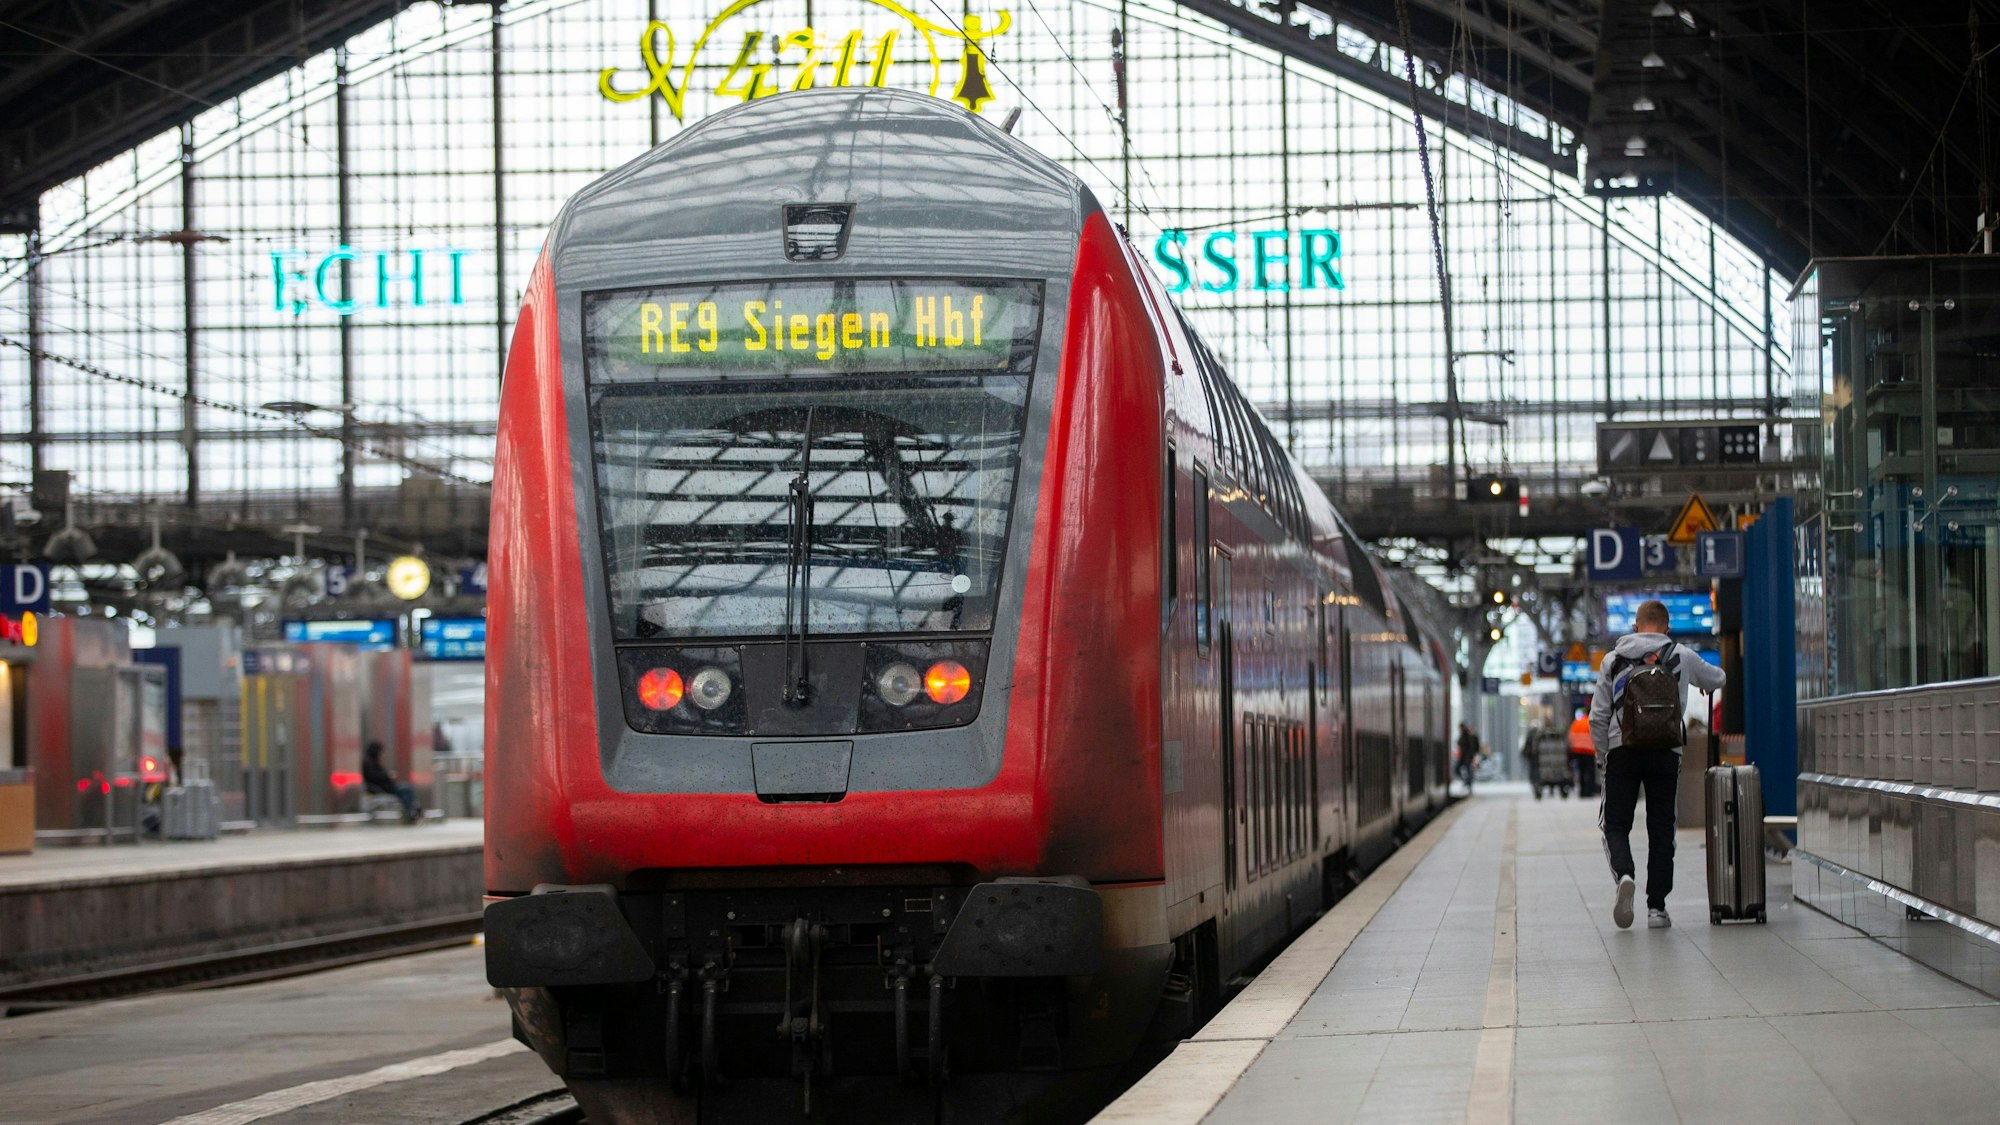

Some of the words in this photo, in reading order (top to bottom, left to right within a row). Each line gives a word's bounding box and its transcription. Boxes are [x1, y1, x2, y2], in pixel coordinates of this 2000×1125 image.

[714, 28, 899, 102] 4711
[641, 302, 718, 353] RE9
[744, 300, 890, 361] Siegen
[915, 295, 984, 347] Hbf
[1593, 528, 1623, 570] D
[1647, 540, 1665, 566] 3
[14, 564, 44, 604] D
[328, 566, 347, 595] 5
